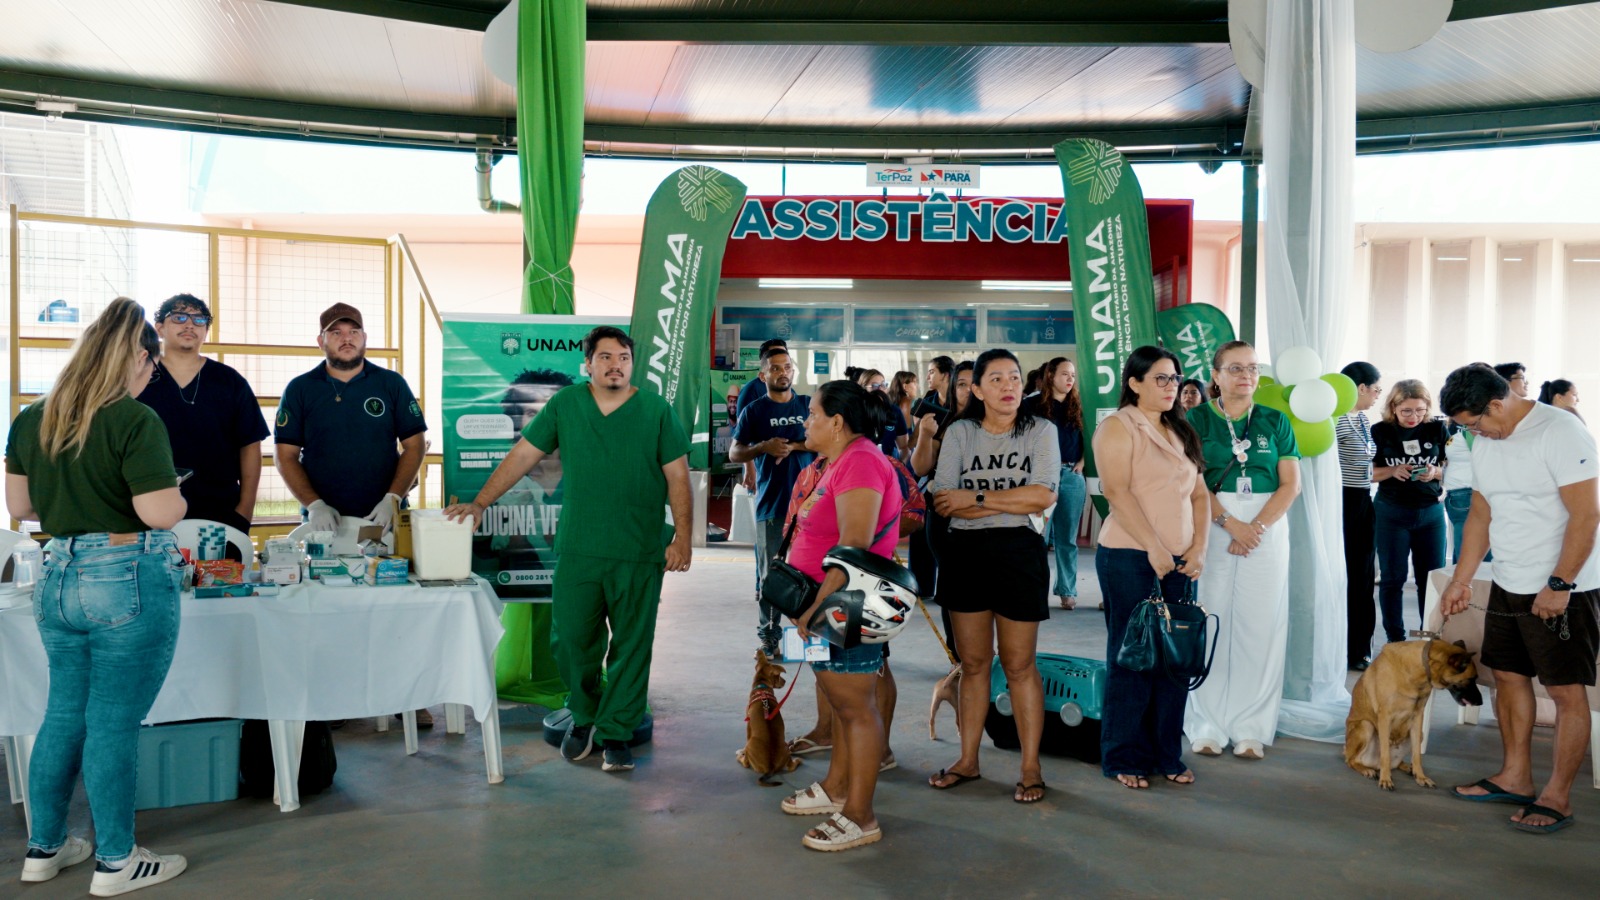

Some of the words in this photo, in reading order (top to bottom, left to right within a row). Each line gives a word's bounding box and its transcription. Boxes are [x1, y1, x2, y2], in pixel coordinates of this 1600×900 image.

[875, 171, 913, 182] TerPaz
[1107, 216, 1116, 265] AMAZÔNIA
[1115, 213, 1126, 282] NATUREZA
[682, 238, 695, 287] AMAZÔNIA
[1112, 267, 1117, 281] DA
[680, 288, 686, 301] DA
[1086, 219, 1115, 394] UNAMA
[1121, 284, 1129, 312] POR
[669, 340, 685, 407] XCELÊNCIA
[680, 310, 690, 338] POR
[685, 245, 703, 310] NATUREZA
[527, 338, 583, 352] UNAM
[1176, 323, 1208, 383] AMA
[770, 415, 805, 427] BOSS
[1384, 455, 1438, 467] UNAMA
[474, 504, 537, 536] DICINA
